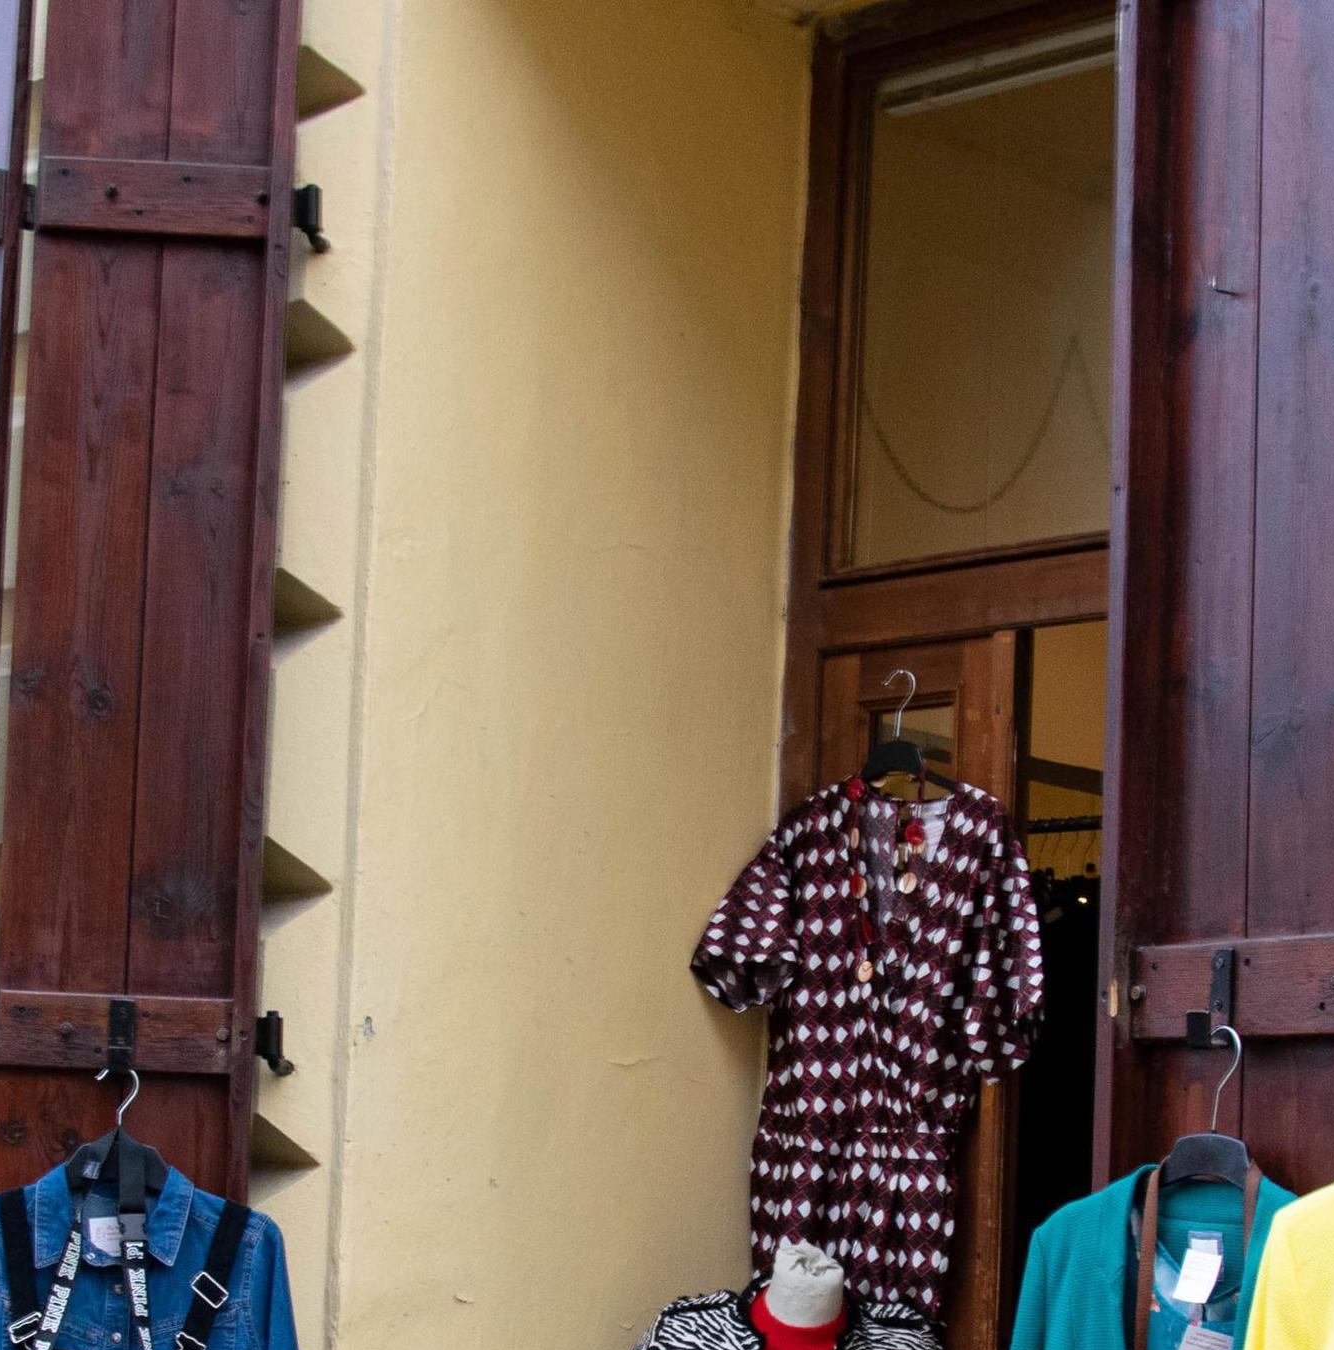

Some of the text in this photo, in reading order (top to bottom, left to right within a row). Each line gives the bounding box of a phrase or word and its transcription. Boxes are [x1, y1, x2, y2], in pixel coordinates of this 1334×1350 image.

[57, 1230, 81, 1281] PINK
[40, 1284, 72, 1334] PINK
[128, 1268, 149, 1317] PINK
